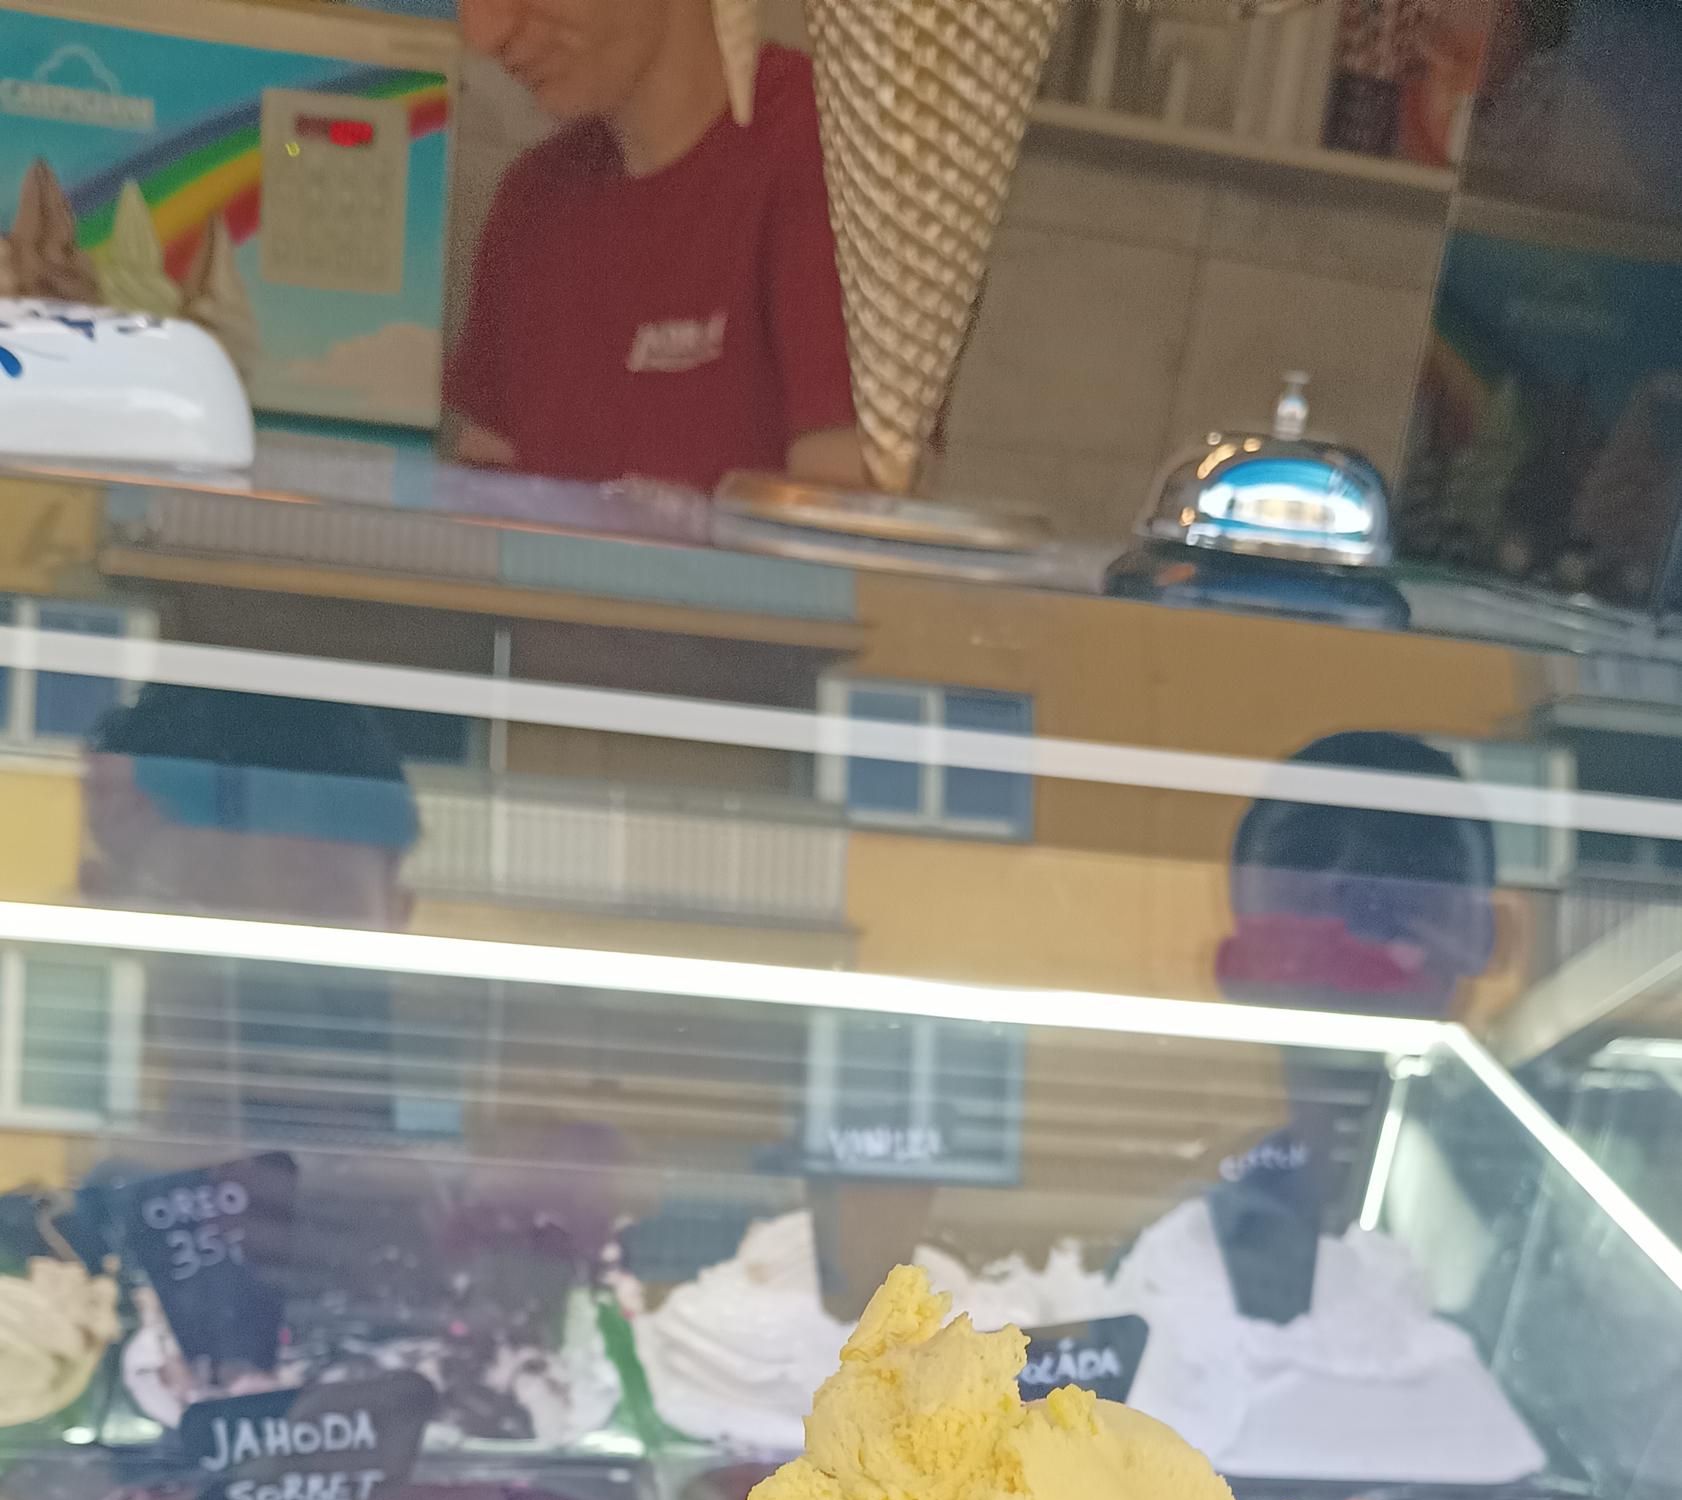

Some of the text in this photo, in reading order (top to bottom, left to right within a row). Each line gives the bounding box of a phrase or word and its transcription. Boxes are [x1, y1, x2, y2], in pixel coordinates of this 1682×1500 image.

[141, 1181, 248, 1230] OREO
[1018, 1338, 1121, 1385] OLÁDA
[201, 1408, 379, 1472] JAHODA
